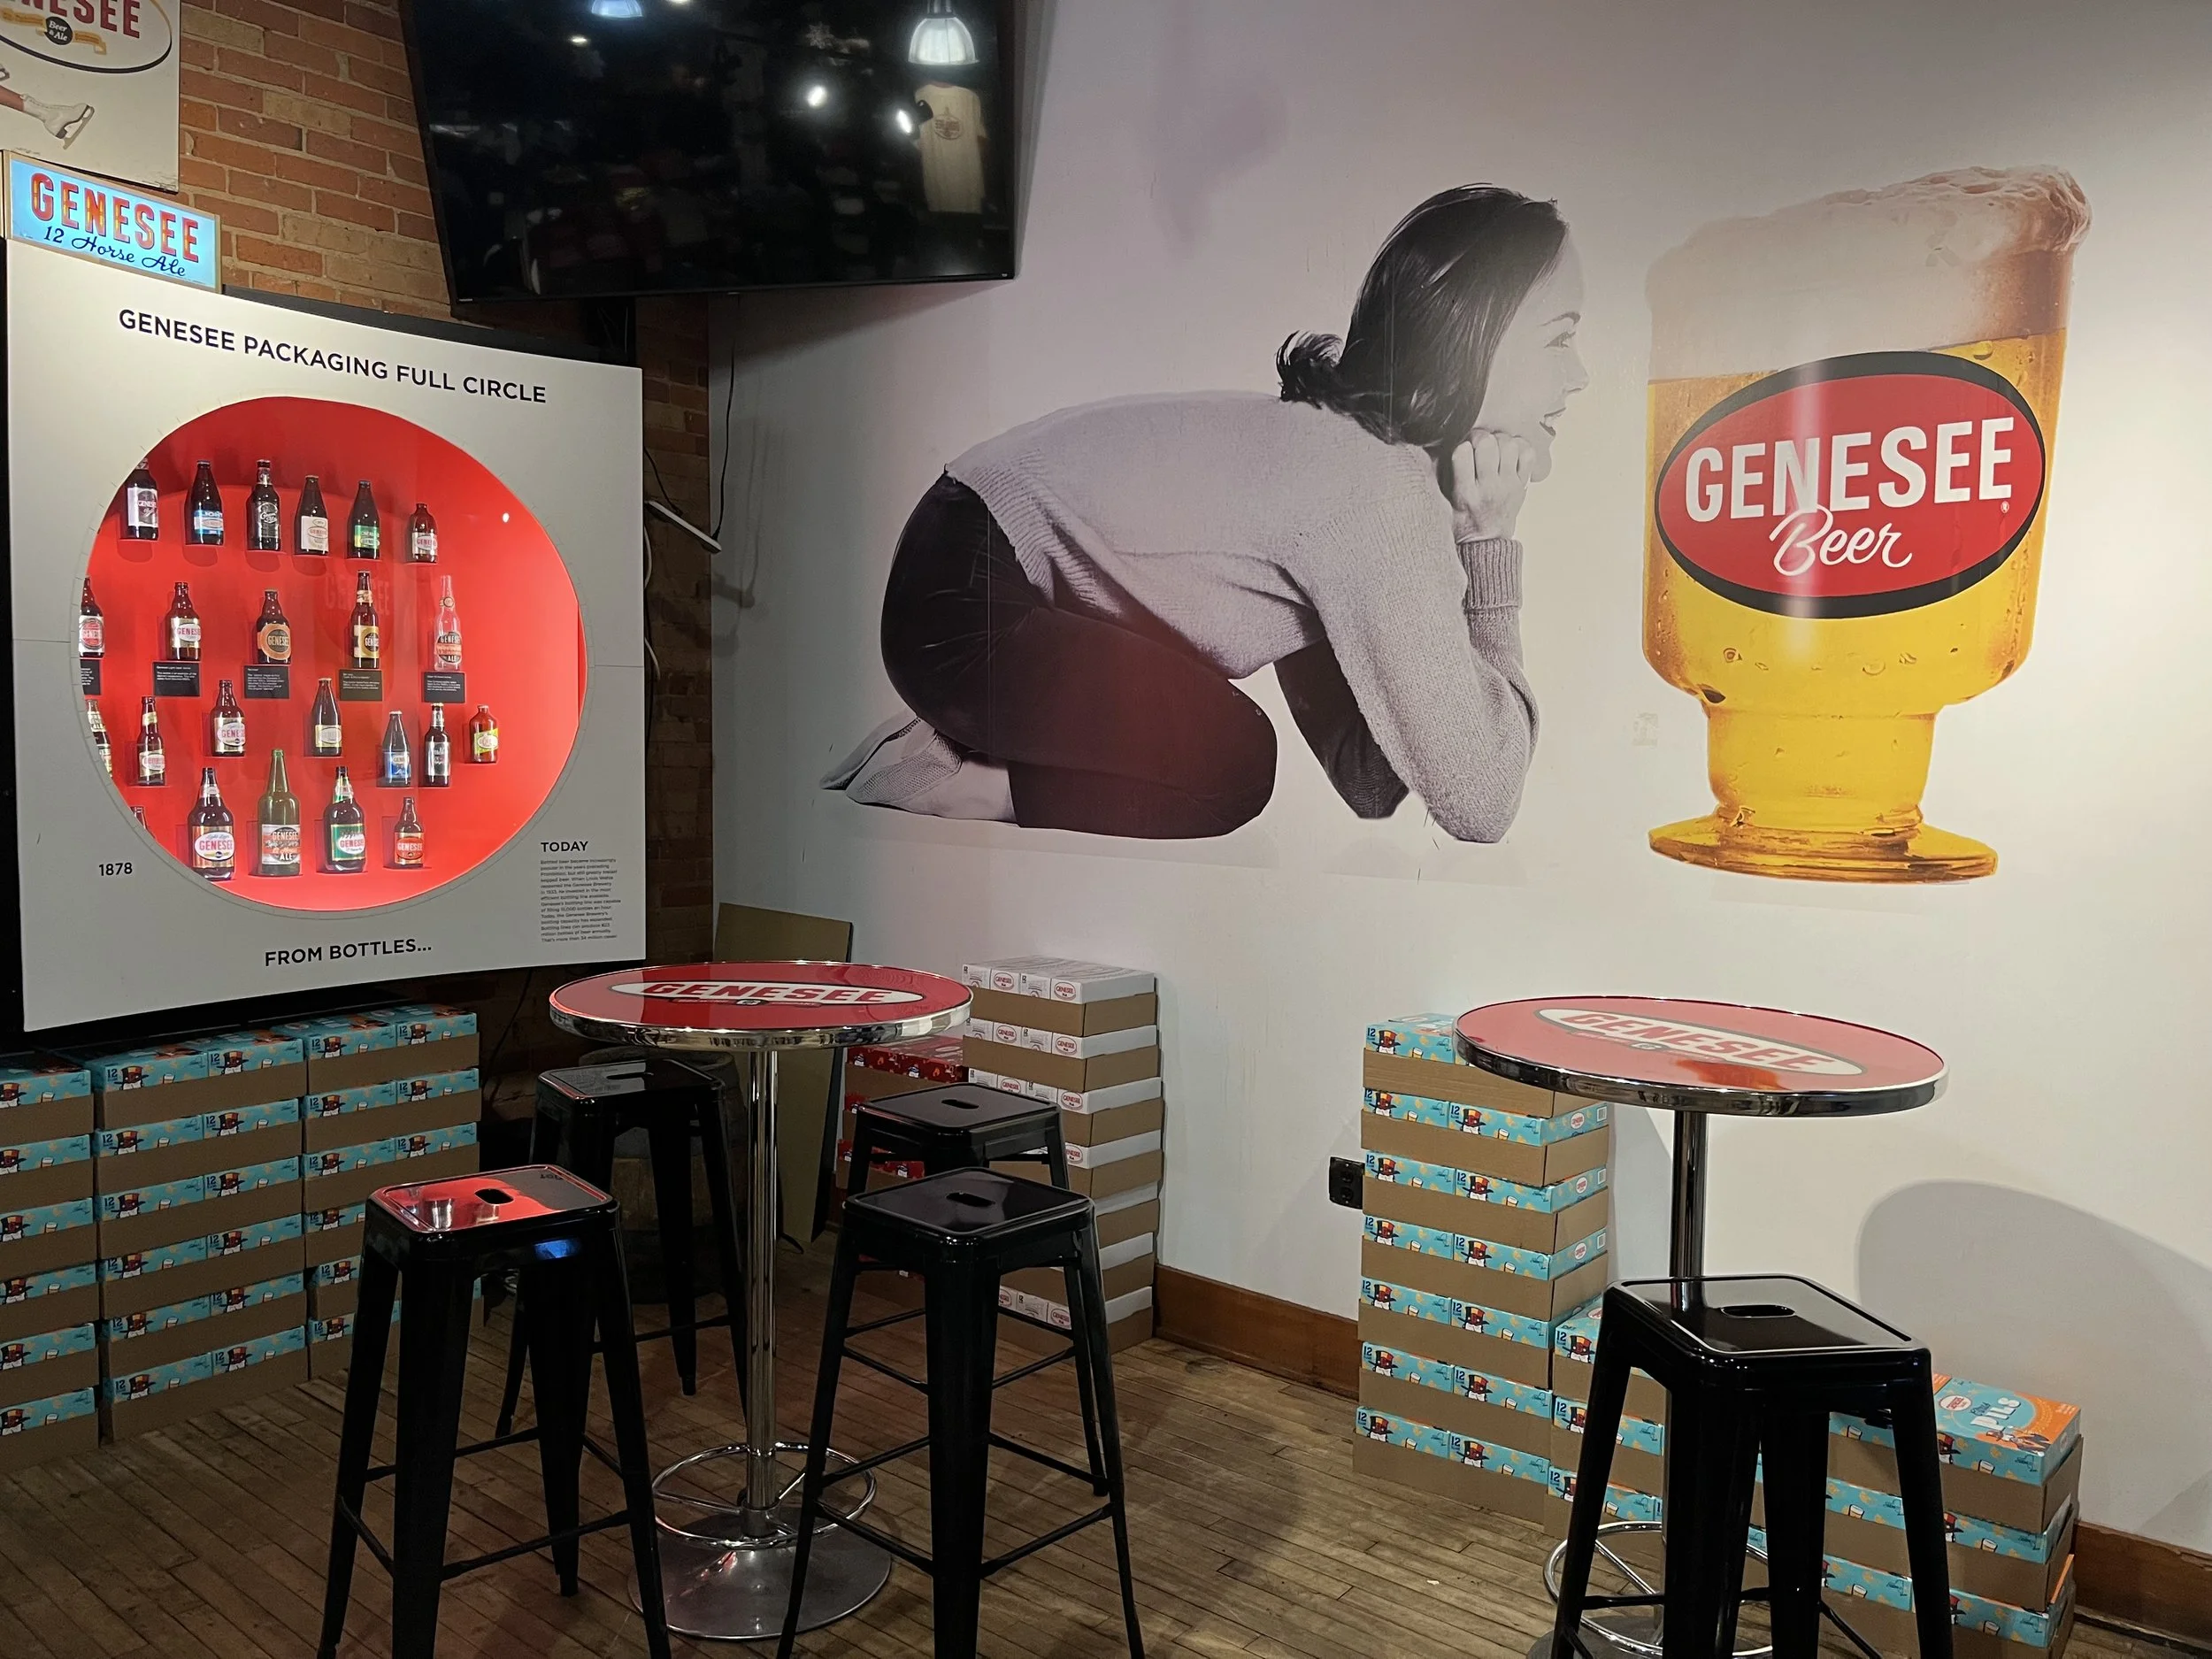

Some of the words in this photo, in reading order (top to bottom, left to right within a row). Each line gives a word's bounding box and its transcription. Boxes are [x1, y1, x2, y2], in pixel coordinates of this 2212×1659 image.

[49, 19, 68, 32] Beer
[54, 32, 68, 42] Ale
[30, 172, 199, 263] GENESEE
[43, 225, 65, 244] 12
[71, 235, 134, 264] Horse
[141, 254, 186, 277] Ale
[119, 308, 235, 351] GENESEE
[243, 337, 389, 380] PACKAGING
[396, 365, 456, 392] FULL
[462, 376, 547, 404] CIRCLE
[1685, 416, 2016, 523] GENESEE
[1768, 503, 1913, 577] Beer
[541, 841, 588, 852] TODAY
[98, 862, 133, 877] 1878
[264, 944, 323, 968] FROM
[328, 937, 433, 962] BOTTLES...
[641, 982, 894, 1002] GENESEE
[399, 1025, 409, 1036] 12
[1368, 1028, 1375, 1037] 12
[312, 1037, 321, 1049] 12
[1560, 1013, 1833, 1070] GENESEE
[211, 1052, 220, 1064] 12
[107, 1068, 118, 1080] 12
[399, 1081, 408, 1093] 12
[1364, 1088, 1372, 1098] 12
[310, 1096, 319, 1108] 12
[1451, 1106, 1460, 1115] 12
[205, 1115, 216, 1127] 12
[102, 1133, 113, 1145] 12
[397, 1138, 406, 1149] 12
[310, 1155, 319, 1167] 12
[1366, 1155, 1375, 1164] 12
[206, 1175, 217, 1187] 12
[1457, 1172, 1466, 1181] 12
[104, 1196, 114, 1210] 12
[309, 1211, 319, 1223] 12
[1365, 1217, 1373, 1226] 12
[210, 1234, 219, 1246] 12
[1456, 1237, 1464, 1247] 12
[107, 1258, 118, 1270] 12
[321, 1265, 330, 1275] 12
[1363, 1280, 1371, 1290] 12
[212, 1292, 223, 1302] 12
[1453, 1302, 1463, 1313] 12
[112, 1317, 123, 1328] 12
[314, 1322, 323, 1332] 12
[1556, 1331, 1566, 1341] 12
[215, 1351, 225, 1363] 12
[1363, 1347, 1372, 1356] 12
[1455, 1370, 1464, 1380] 12
[115, 1379, 126, 1391] 12
[1556, 1402, 1566, 1413] 12
[1357, 1411, 1367, 1422] 12
[1970, 1397, 2021, 1431] PILS
[1451, 1435, 1461, 1447] 12
[1550, 1472, 1560, 1483] 12
